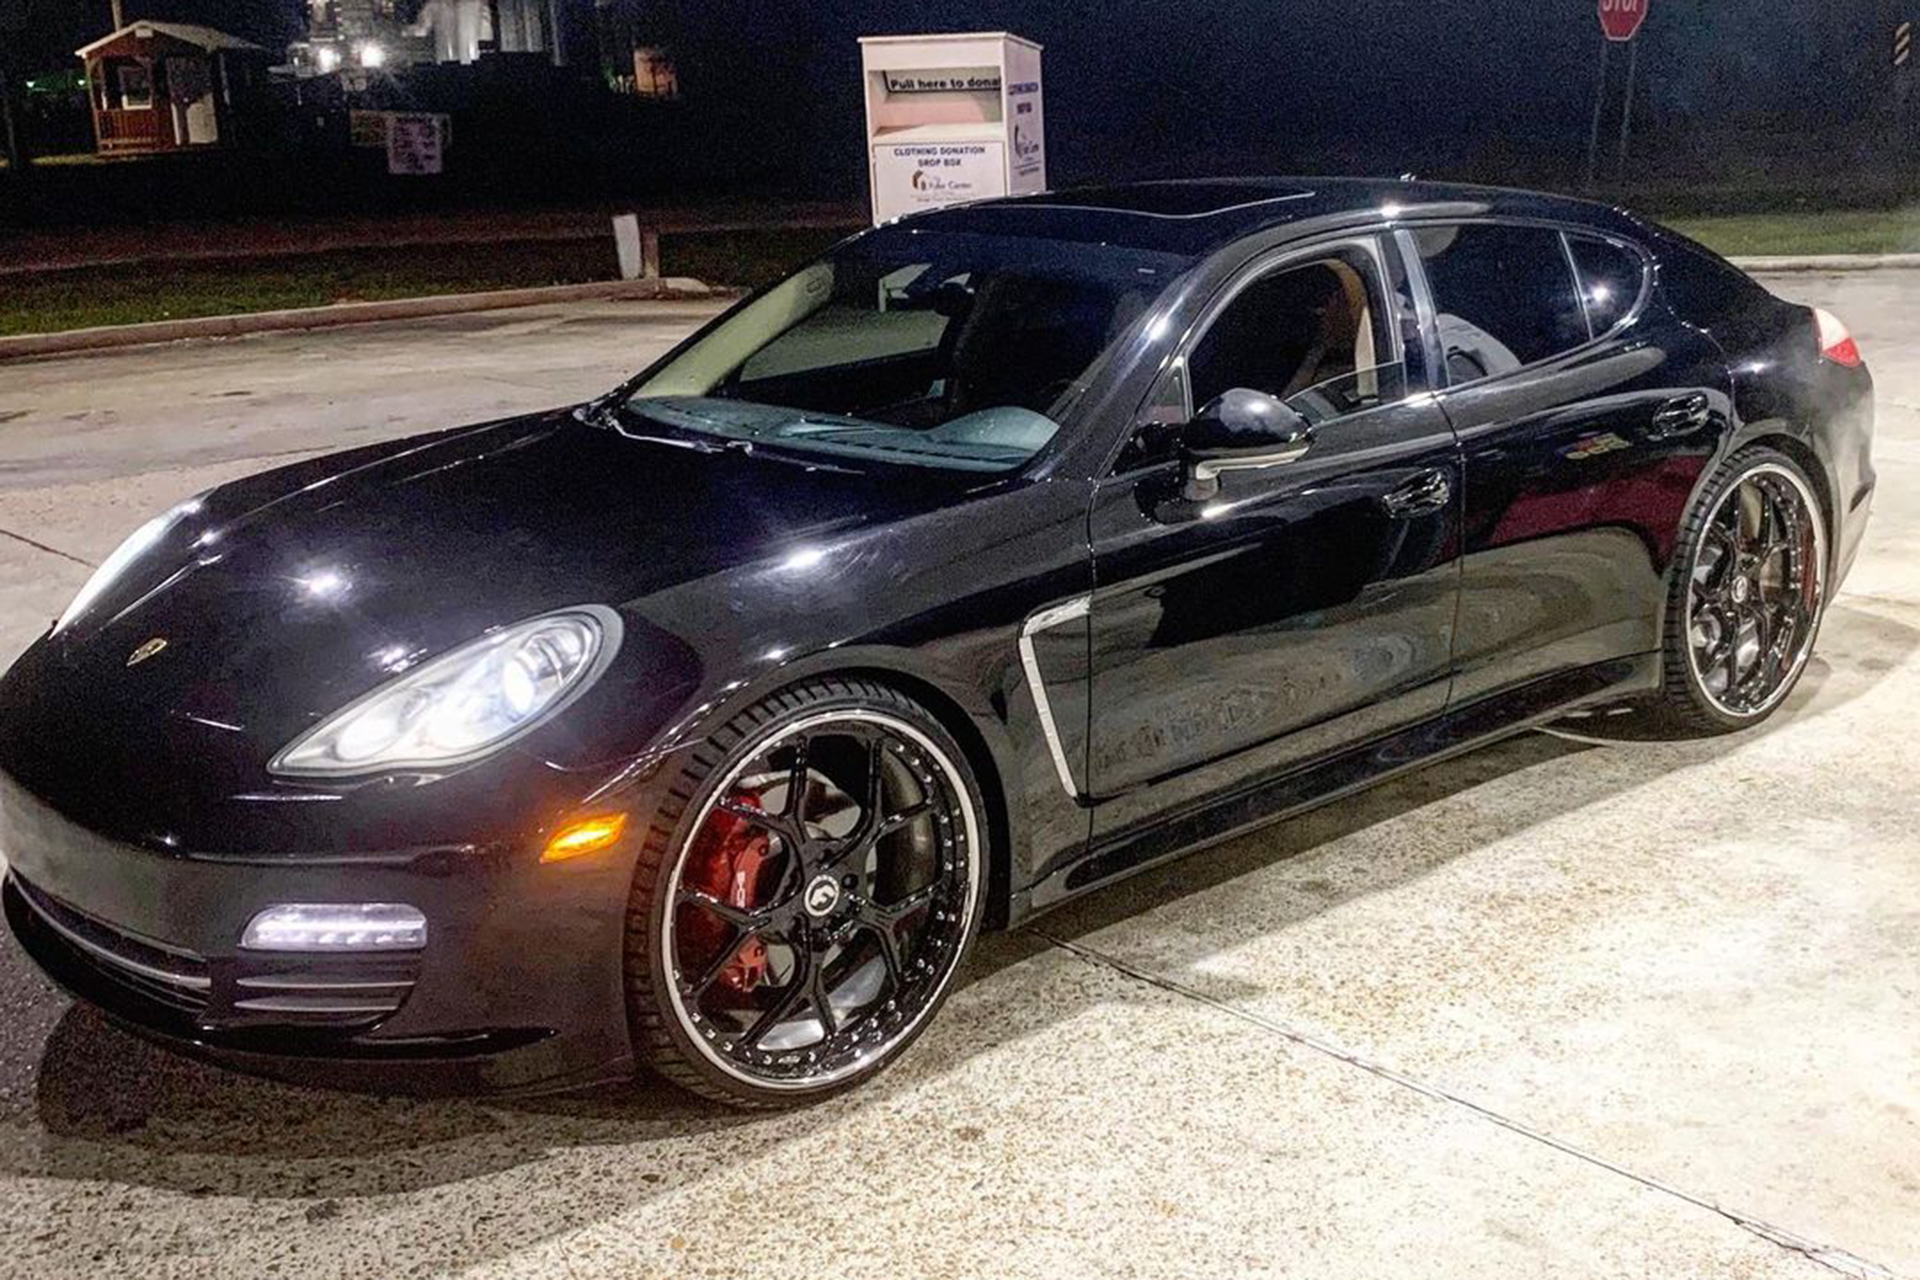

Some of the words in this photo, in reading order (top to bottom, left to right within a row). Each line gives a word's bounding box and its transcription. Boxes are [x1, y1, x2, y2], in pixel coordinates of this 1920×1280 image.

[891, 79, 915, 89] Pull
[918, 79, 947, 88] here
[951, 78, 964, 88] to
[894, 147, 938, 156] CLOTHING
[940, 146, 986, 155] DONATION
